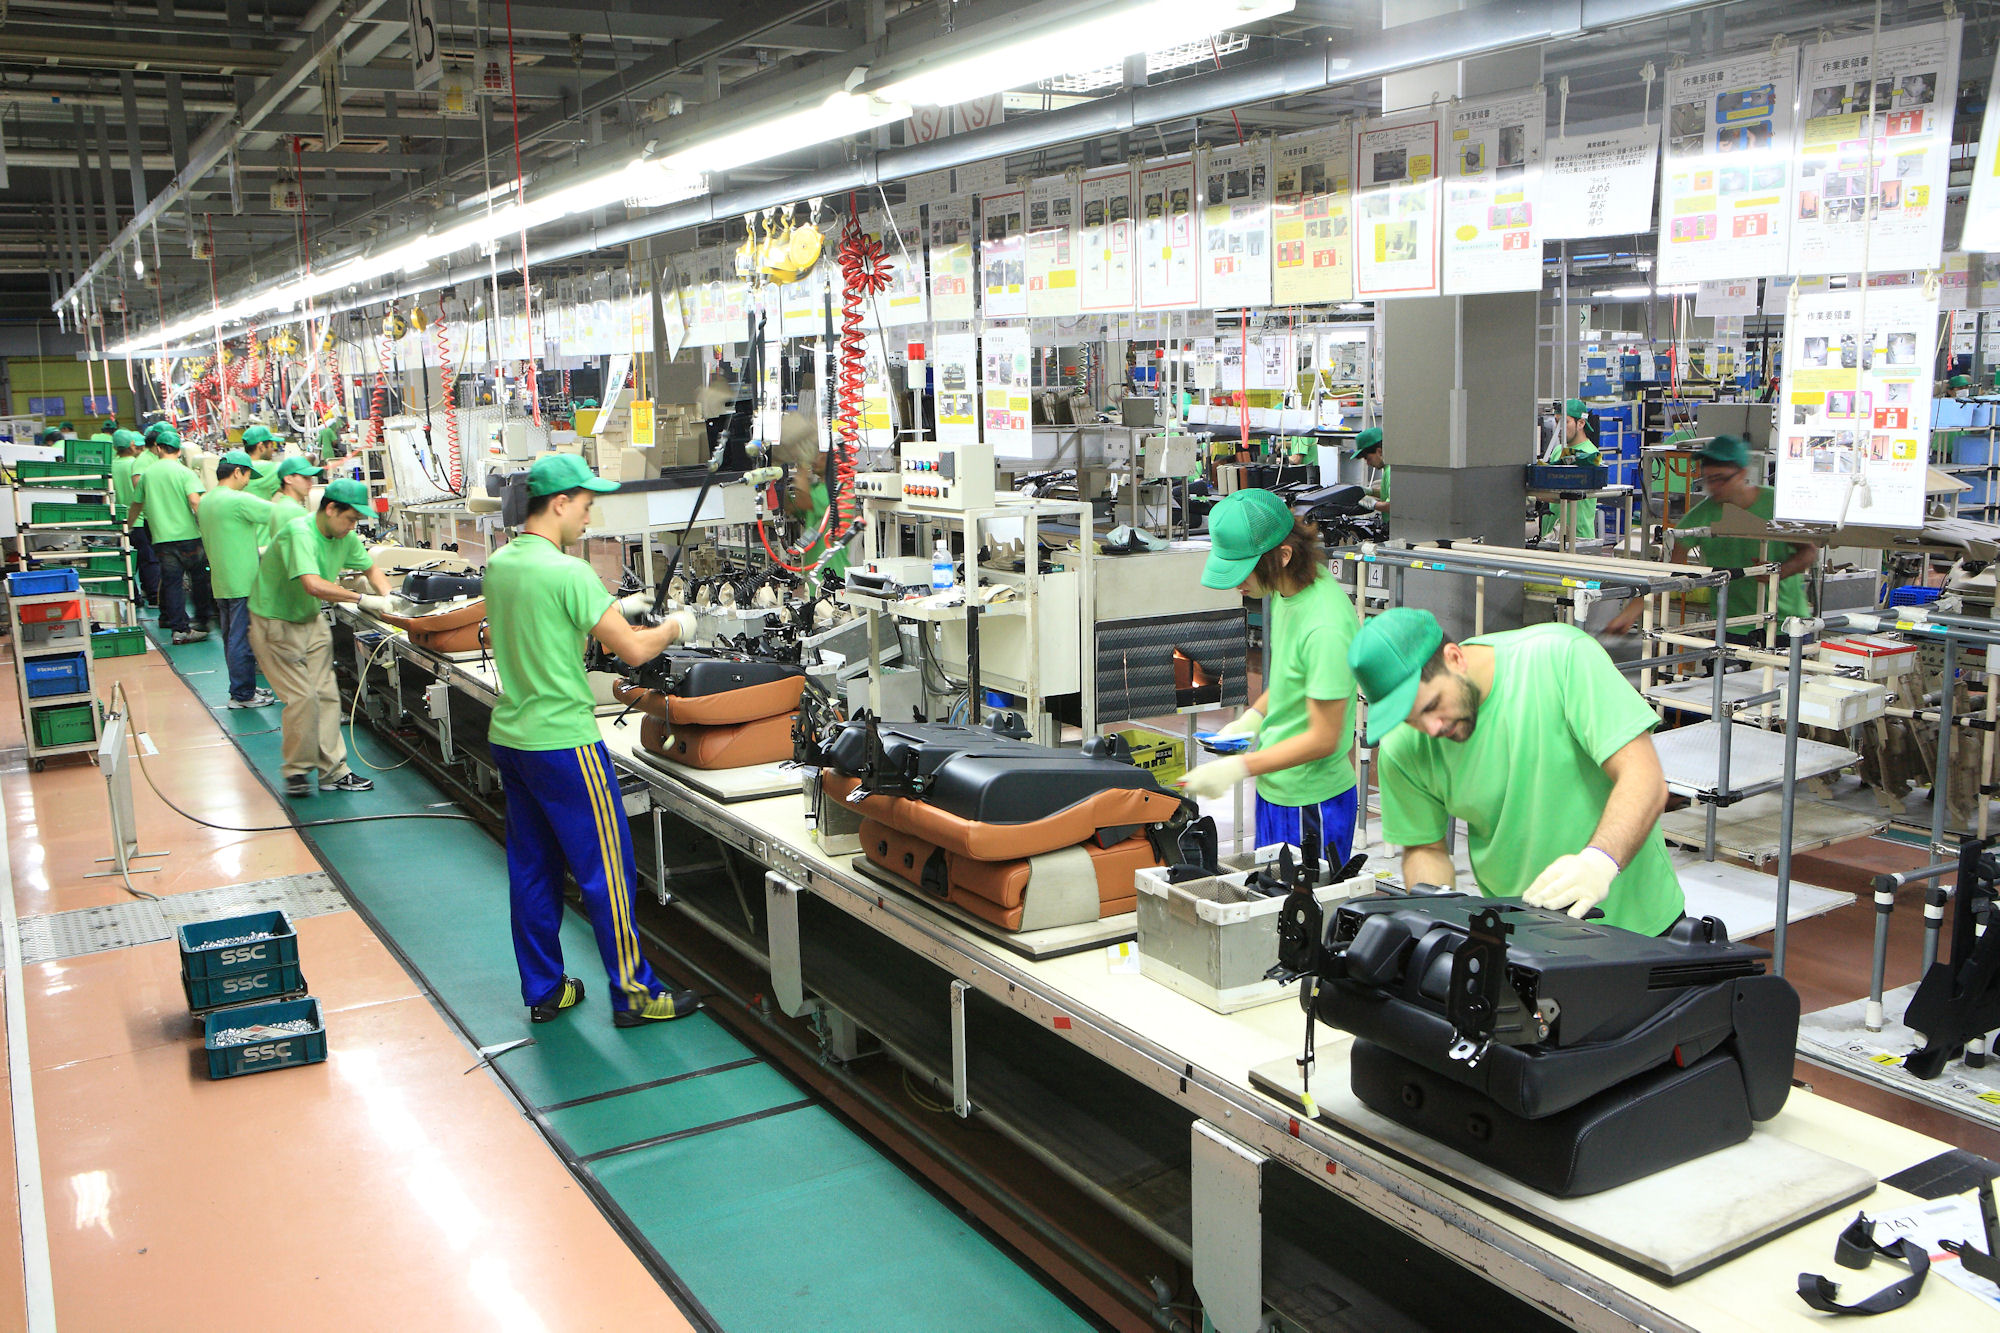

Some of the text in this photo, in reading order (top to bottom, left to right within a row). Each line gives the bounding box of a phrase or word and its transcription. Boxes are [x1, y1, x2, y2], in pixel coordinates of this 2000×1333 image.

[1823, 56, 1868, 72] 作業要領書
[1683, 71, 1724, 87] 作業要領書
[1332, 561, 1339, 575] 6
[1372, 569, 1379, 583] 4
[220, 944, 267, 966] SSC
[222, 973, 269, 994] SSC
[243, 1041, 292, 1063] SSC
